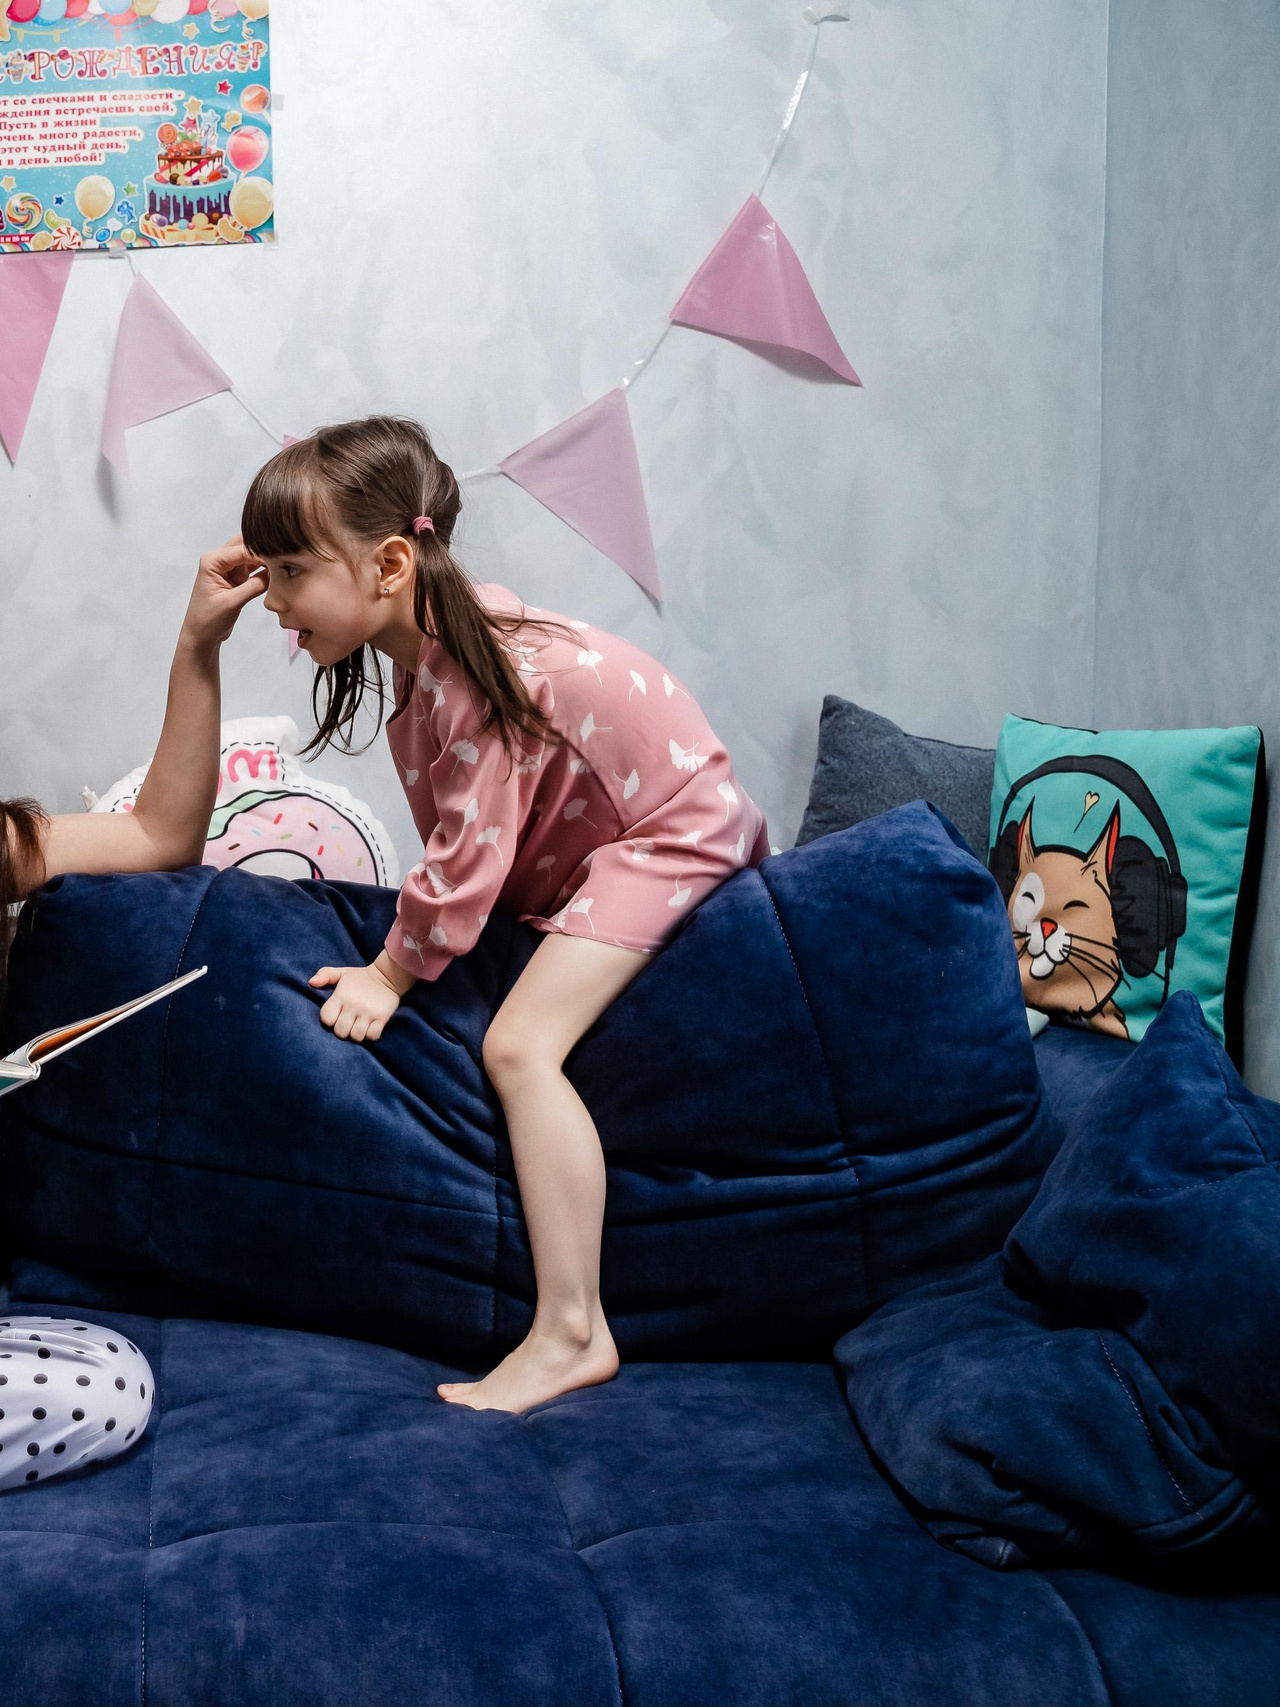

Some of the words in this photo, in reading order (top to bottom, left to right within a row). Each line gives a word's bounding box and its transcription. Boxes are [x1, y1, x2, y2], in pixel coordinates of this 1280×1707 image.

[31, 95, 94, 104] свечками
[112, 92, 173, 101] сладости
[55, 105, 134, 116] встречаешь
[139, 102, 174, 113] свой,
[53, 119, 97, 127] жизни
[39, 131, 78, 140] много
[83, 129, 141, 140] радости,
[0, 146, 28, 154] этот
[33, 141, 86, 154] чудный
[91, 141, 126, 150] день,
[19, 157, 50, 166] день
[54, 153, 102, 164] любой!
